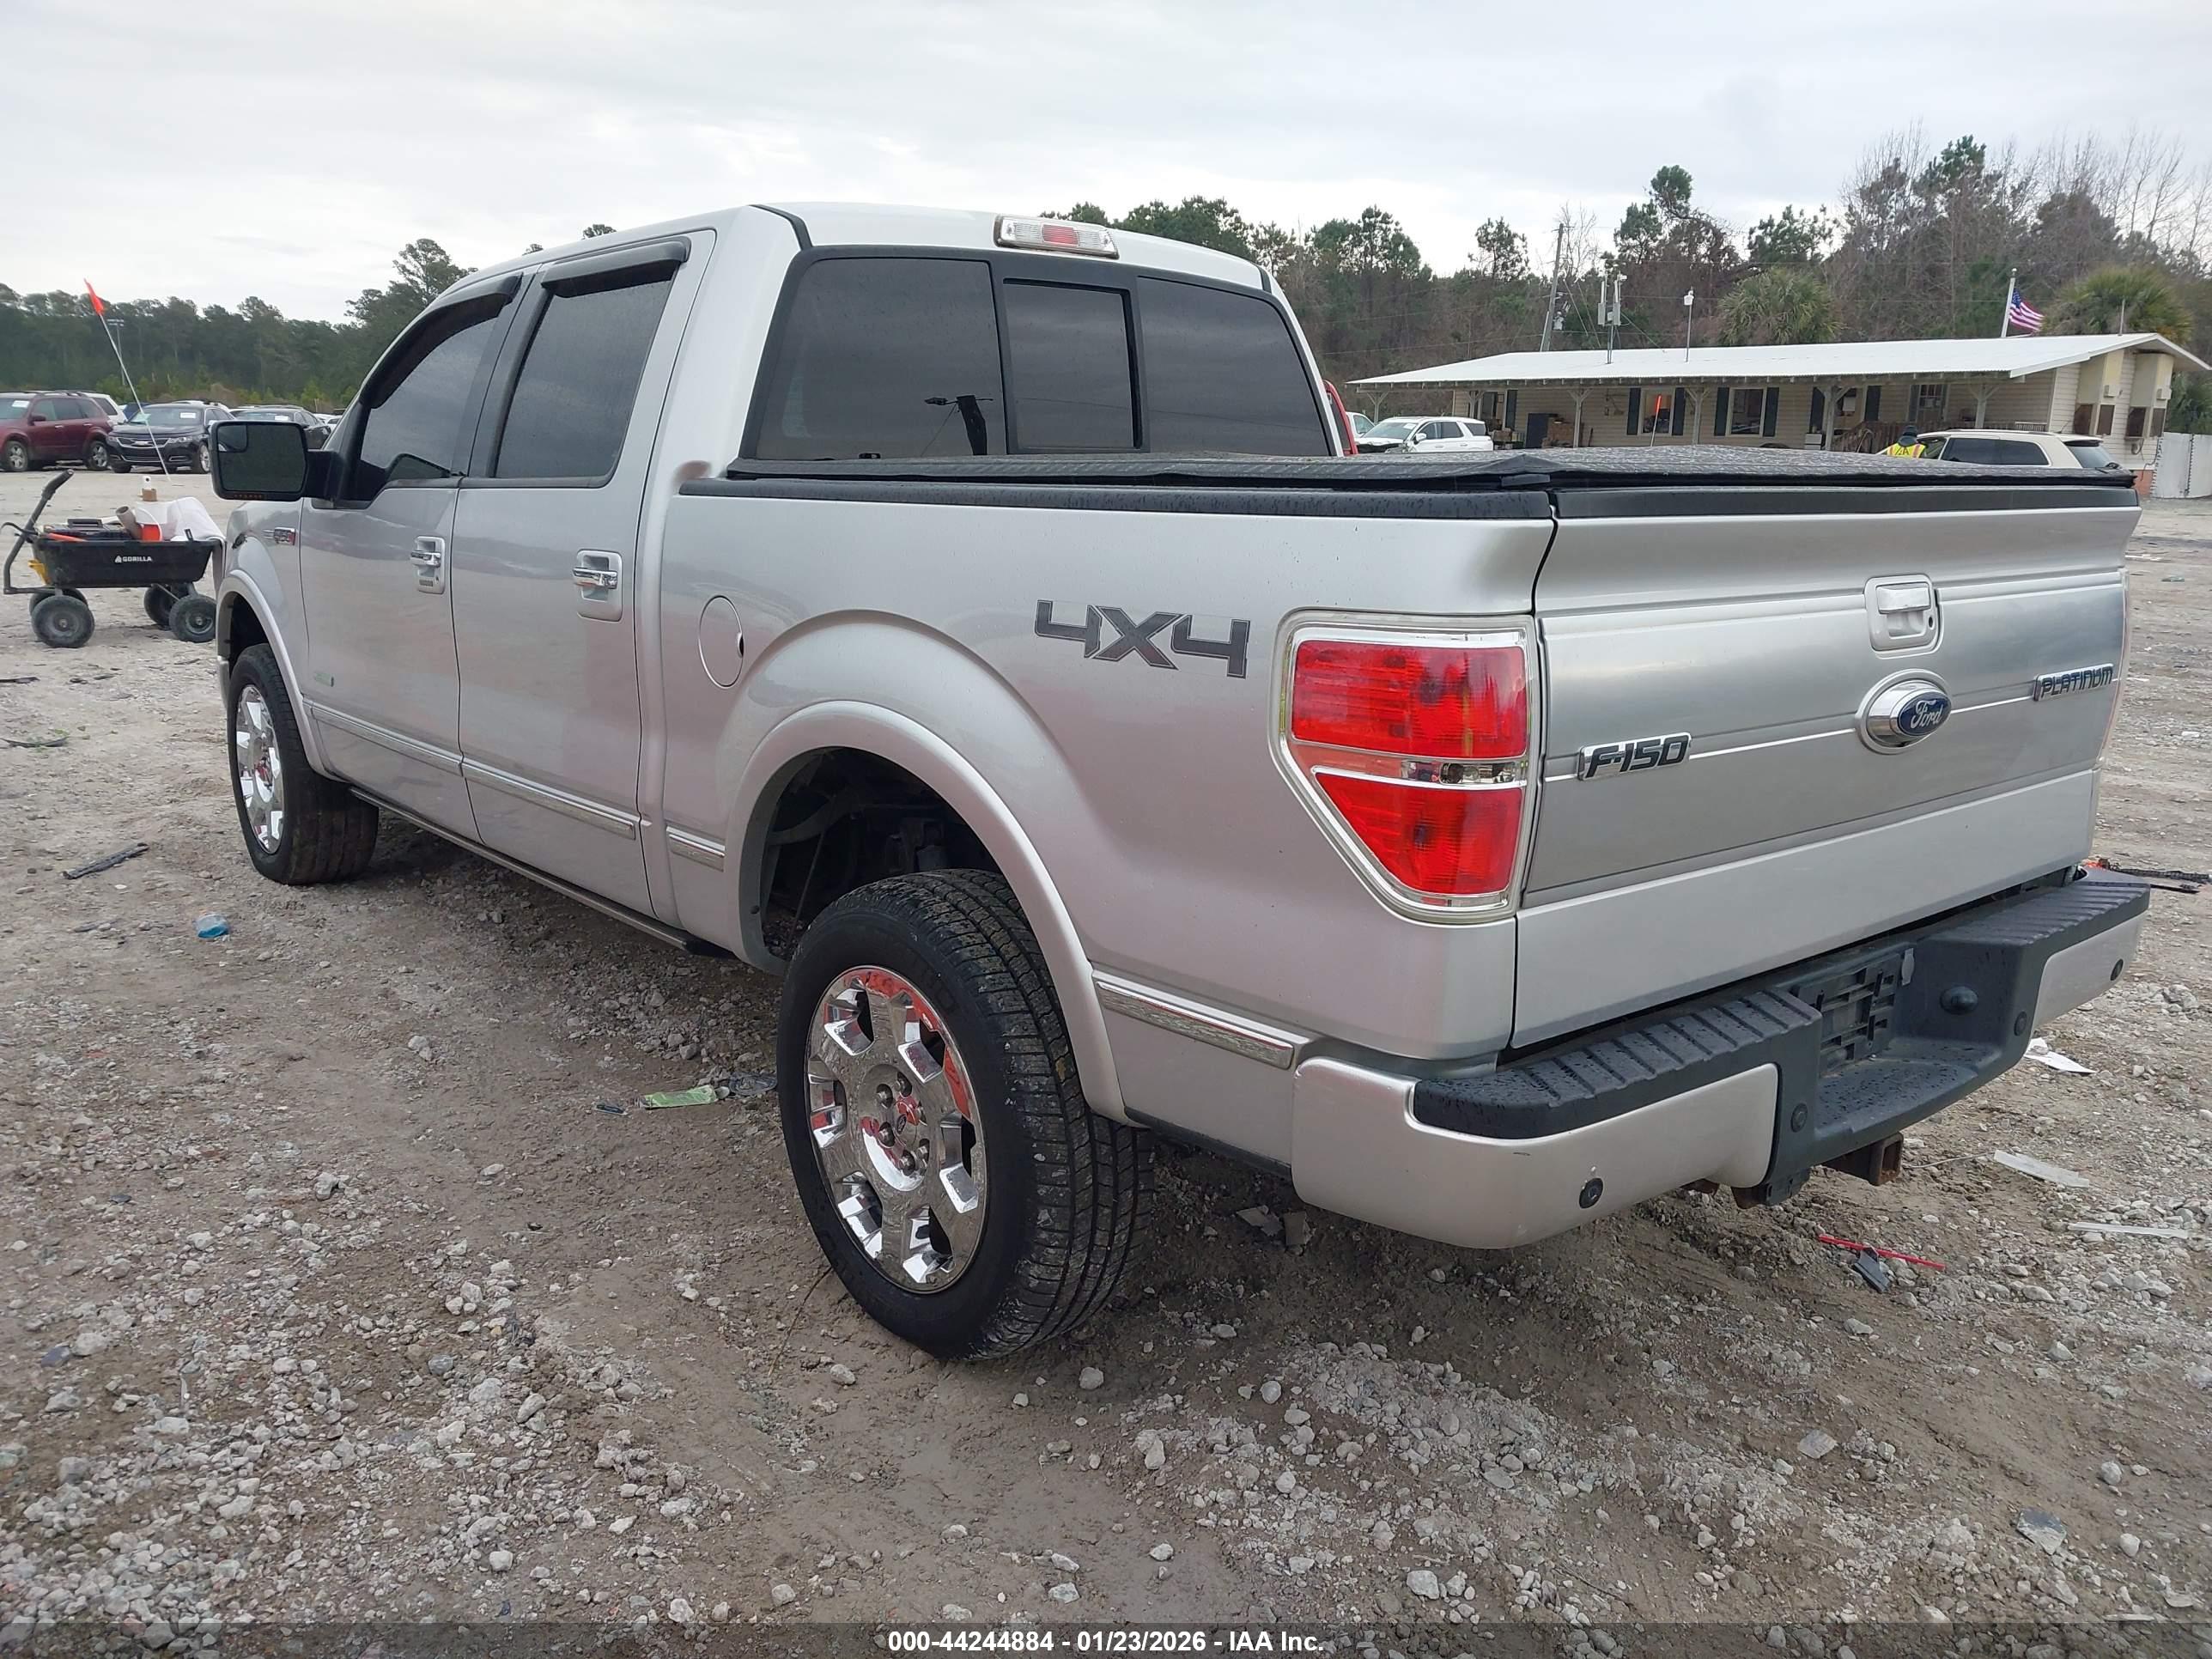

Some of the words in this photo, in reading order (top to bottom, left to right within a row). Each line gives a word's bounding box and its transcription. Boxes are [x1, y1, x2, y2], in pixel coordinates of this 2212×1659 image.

[2039, 665, 2114, 699] PLATINUM
[1910, 699, 1944, 729] Ford
[1583, 733, 1691, 779] F-150
